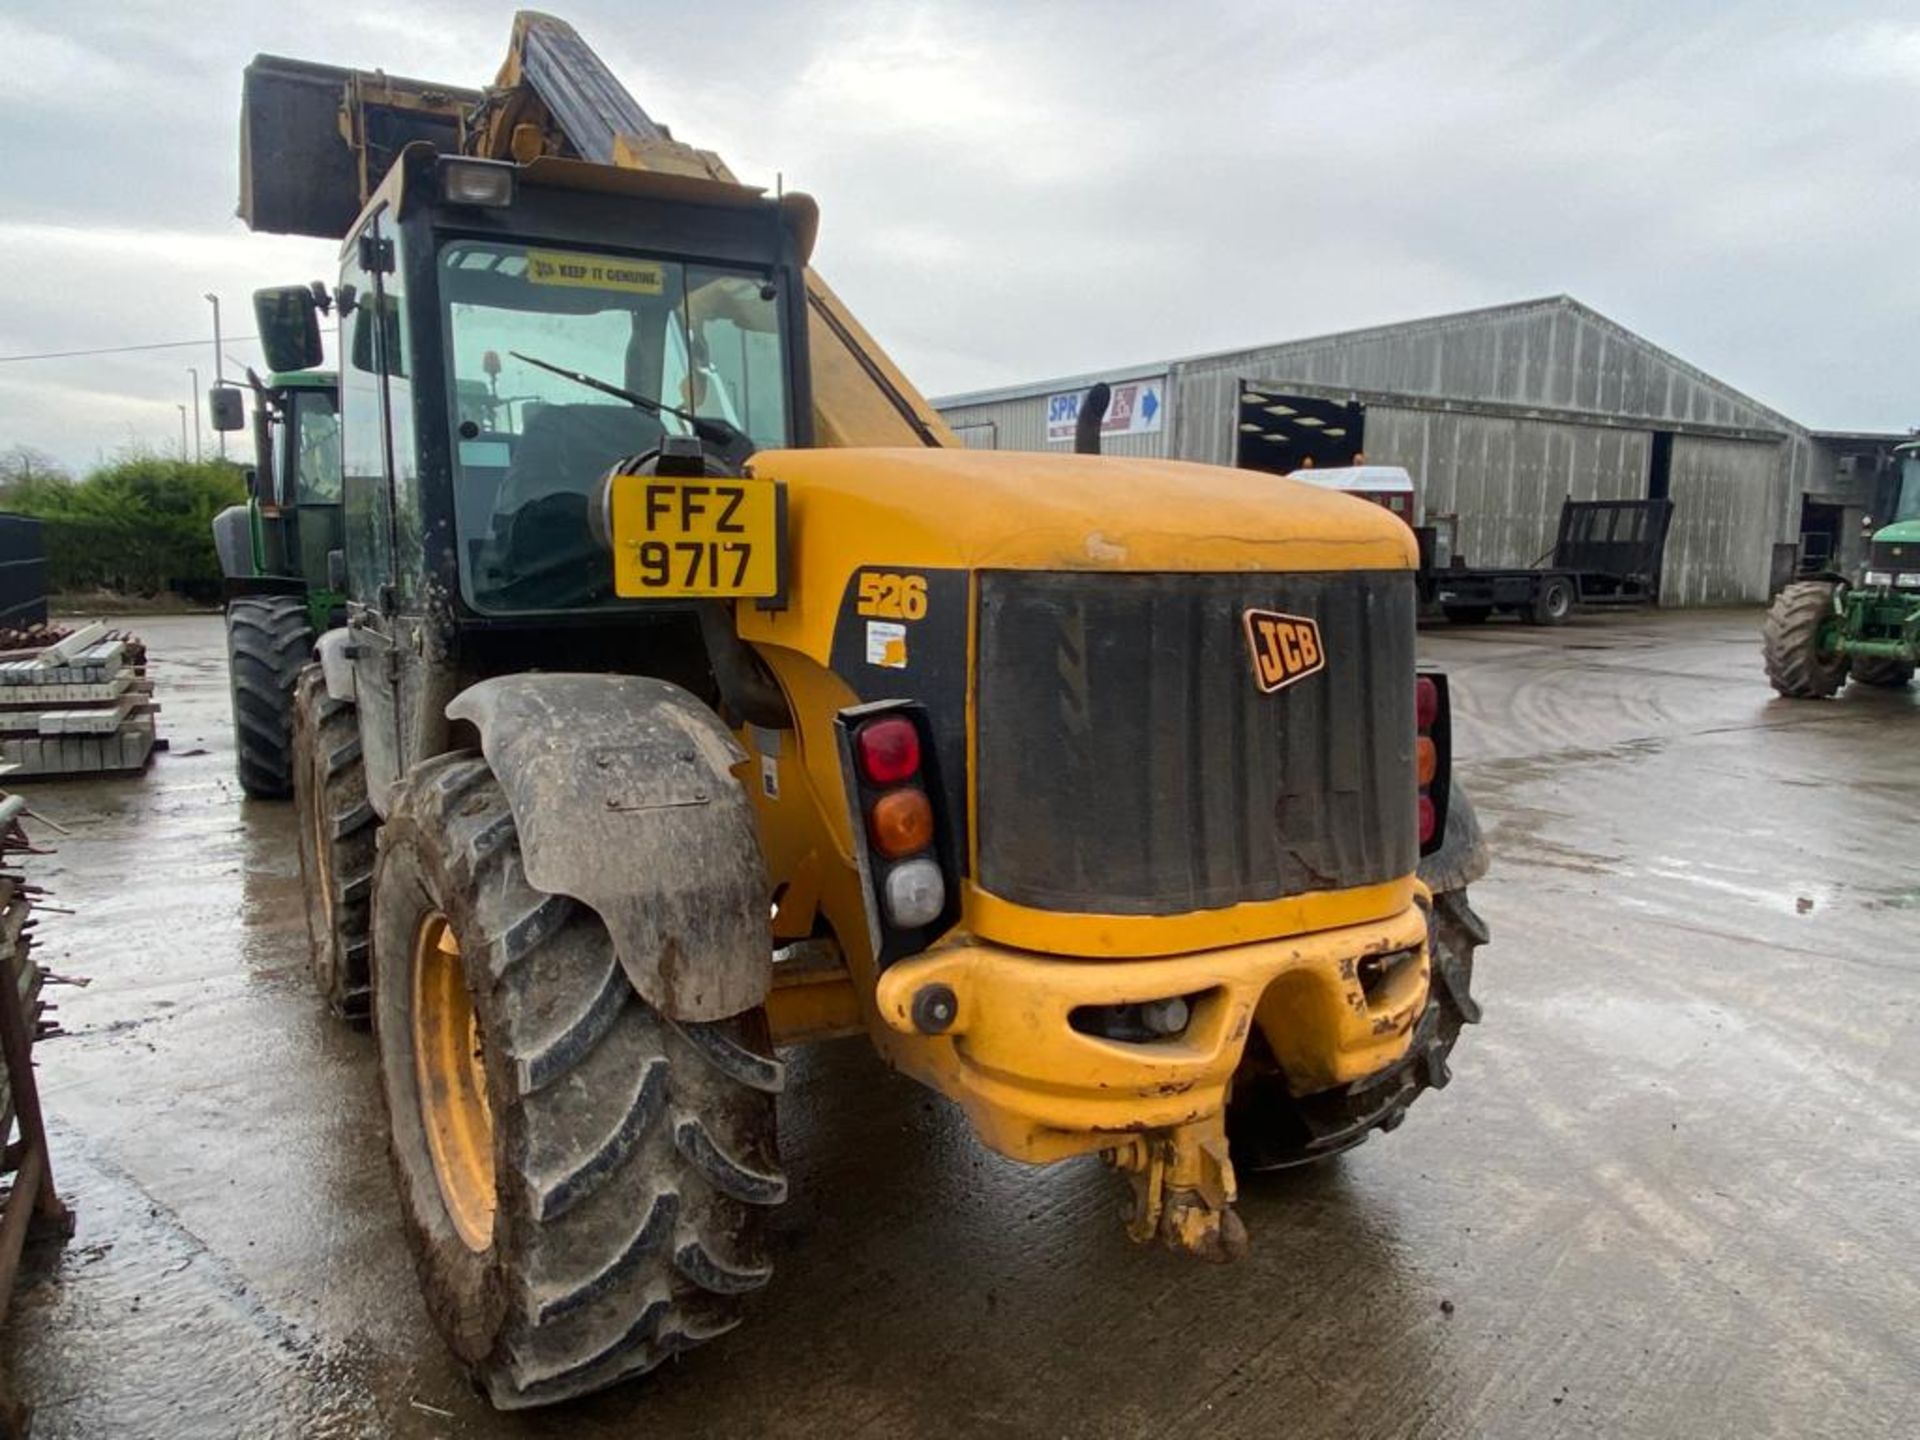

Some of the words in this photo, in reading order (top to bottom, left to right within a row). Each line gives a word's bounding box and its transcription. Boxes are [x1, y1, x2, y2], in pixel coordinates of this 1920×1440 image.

[559, 264, 587, 279] KEEP
[592, 267, 603, 281] IT
[1049, 393, 1080, 422] SPR
[646, 485, 745, 533] FFZ
[640, 541, 752, 588] 9717
[858, 572, 928, 621] 526
[1257, 620, 1318, 683] JCB
